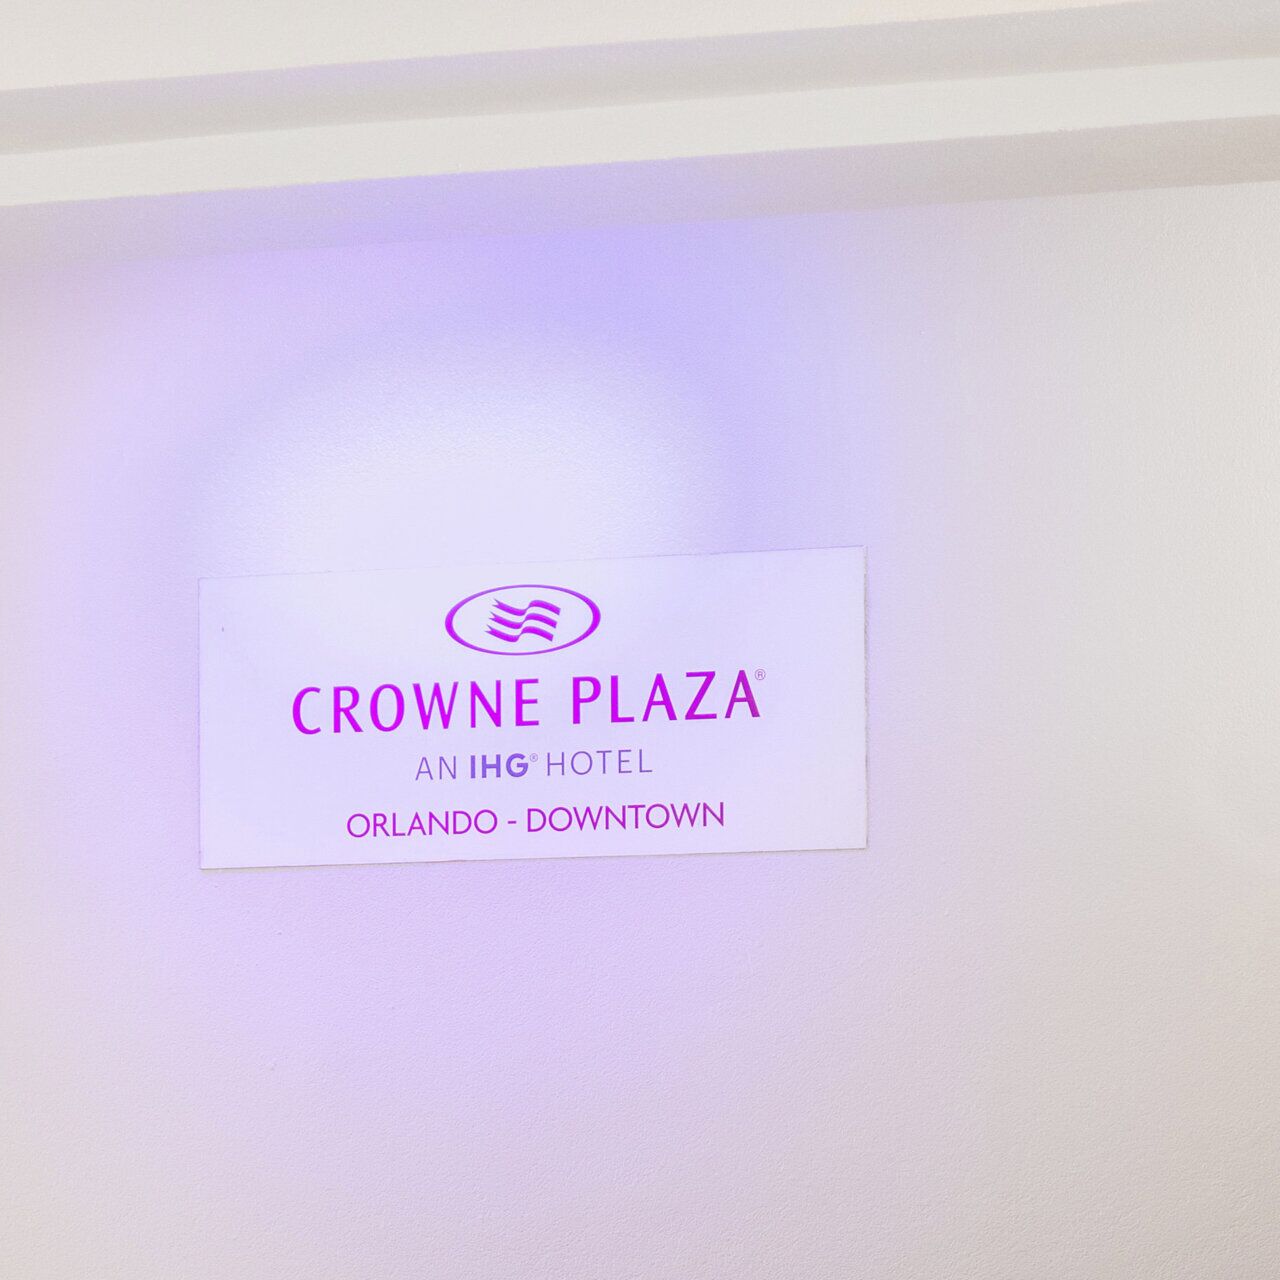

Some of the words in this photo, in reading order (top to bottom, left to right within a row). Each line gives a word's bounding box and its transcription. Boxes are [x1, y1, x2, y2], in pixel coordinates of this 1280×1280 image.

[292, 678, 540, 735] CROWNE
[415, 755, 457, 781] AN
[547, 749, 653, 777] HOTEL
[346, 809, 498, 838] ORLANDO
[527, 801, 724, 833] DOWNTOWN
